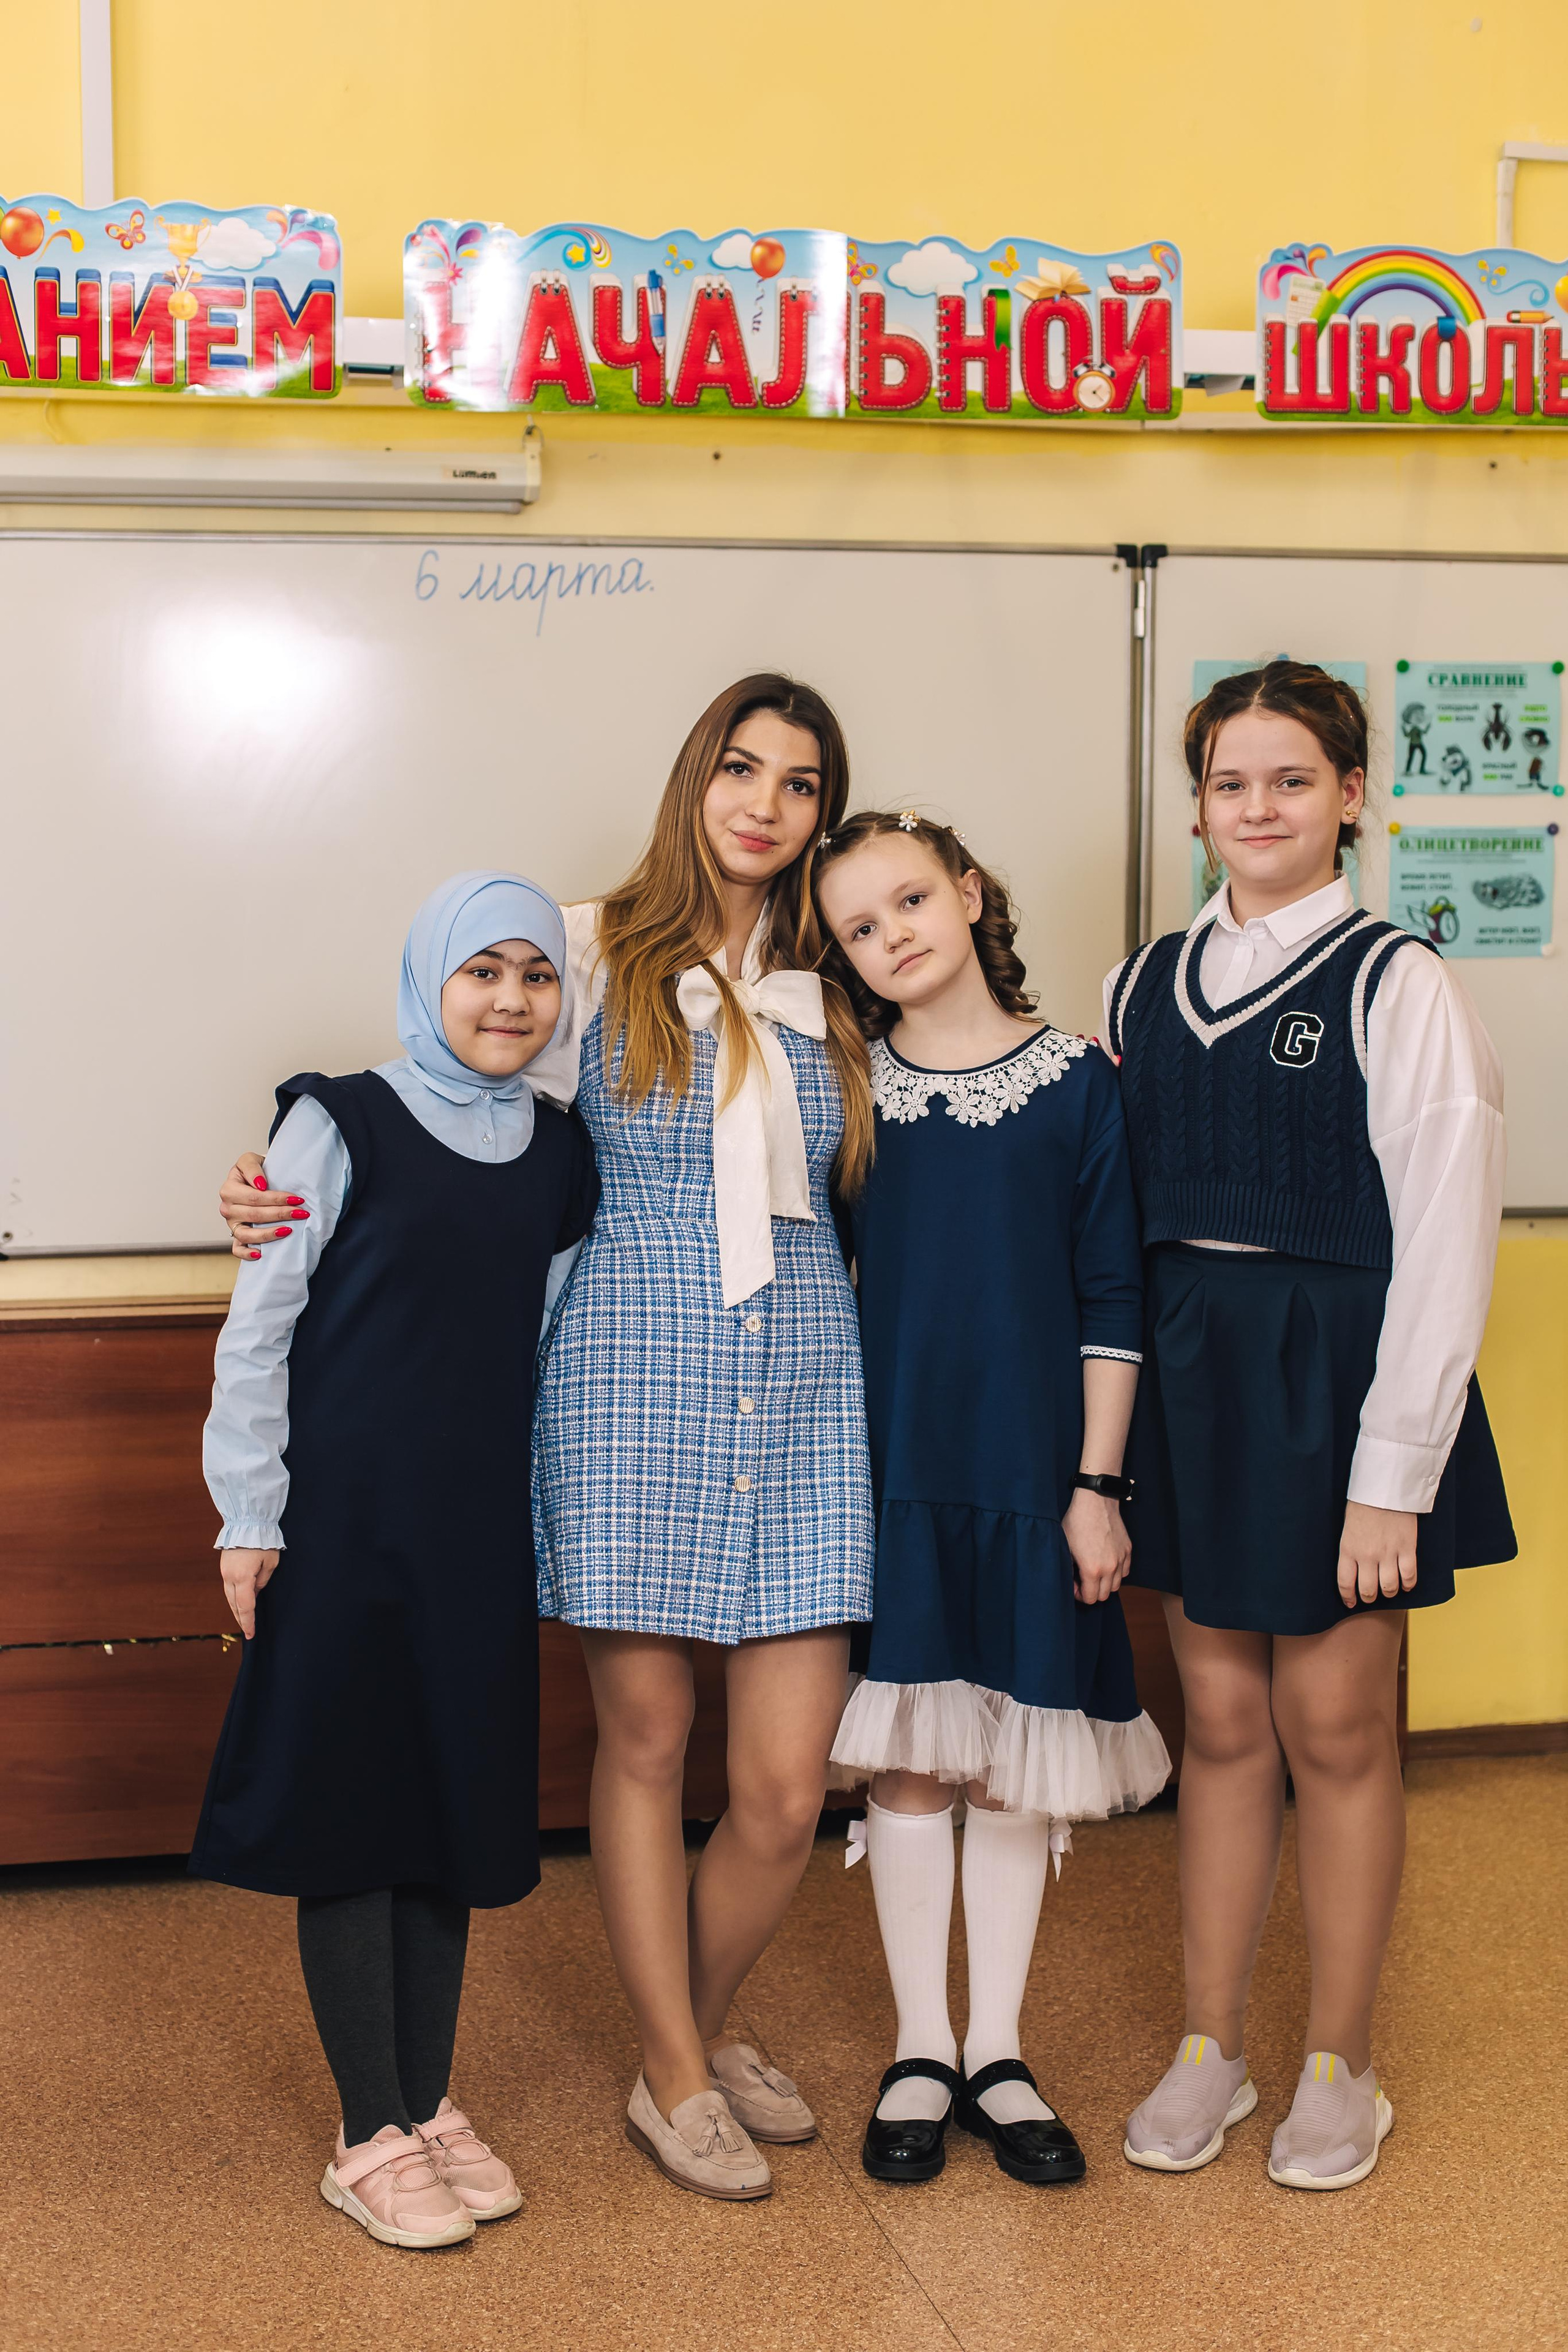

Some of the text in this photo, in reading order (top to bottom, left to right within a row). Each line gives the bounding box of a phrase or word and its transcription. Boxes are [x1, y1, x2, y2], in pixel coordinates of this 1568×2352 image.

[416, 549, 655, 637] 6 марта.
[1428, 672, 1526, 687] СРАВНЕНИЕ
[1270, 1011, 1324, 1068] G
